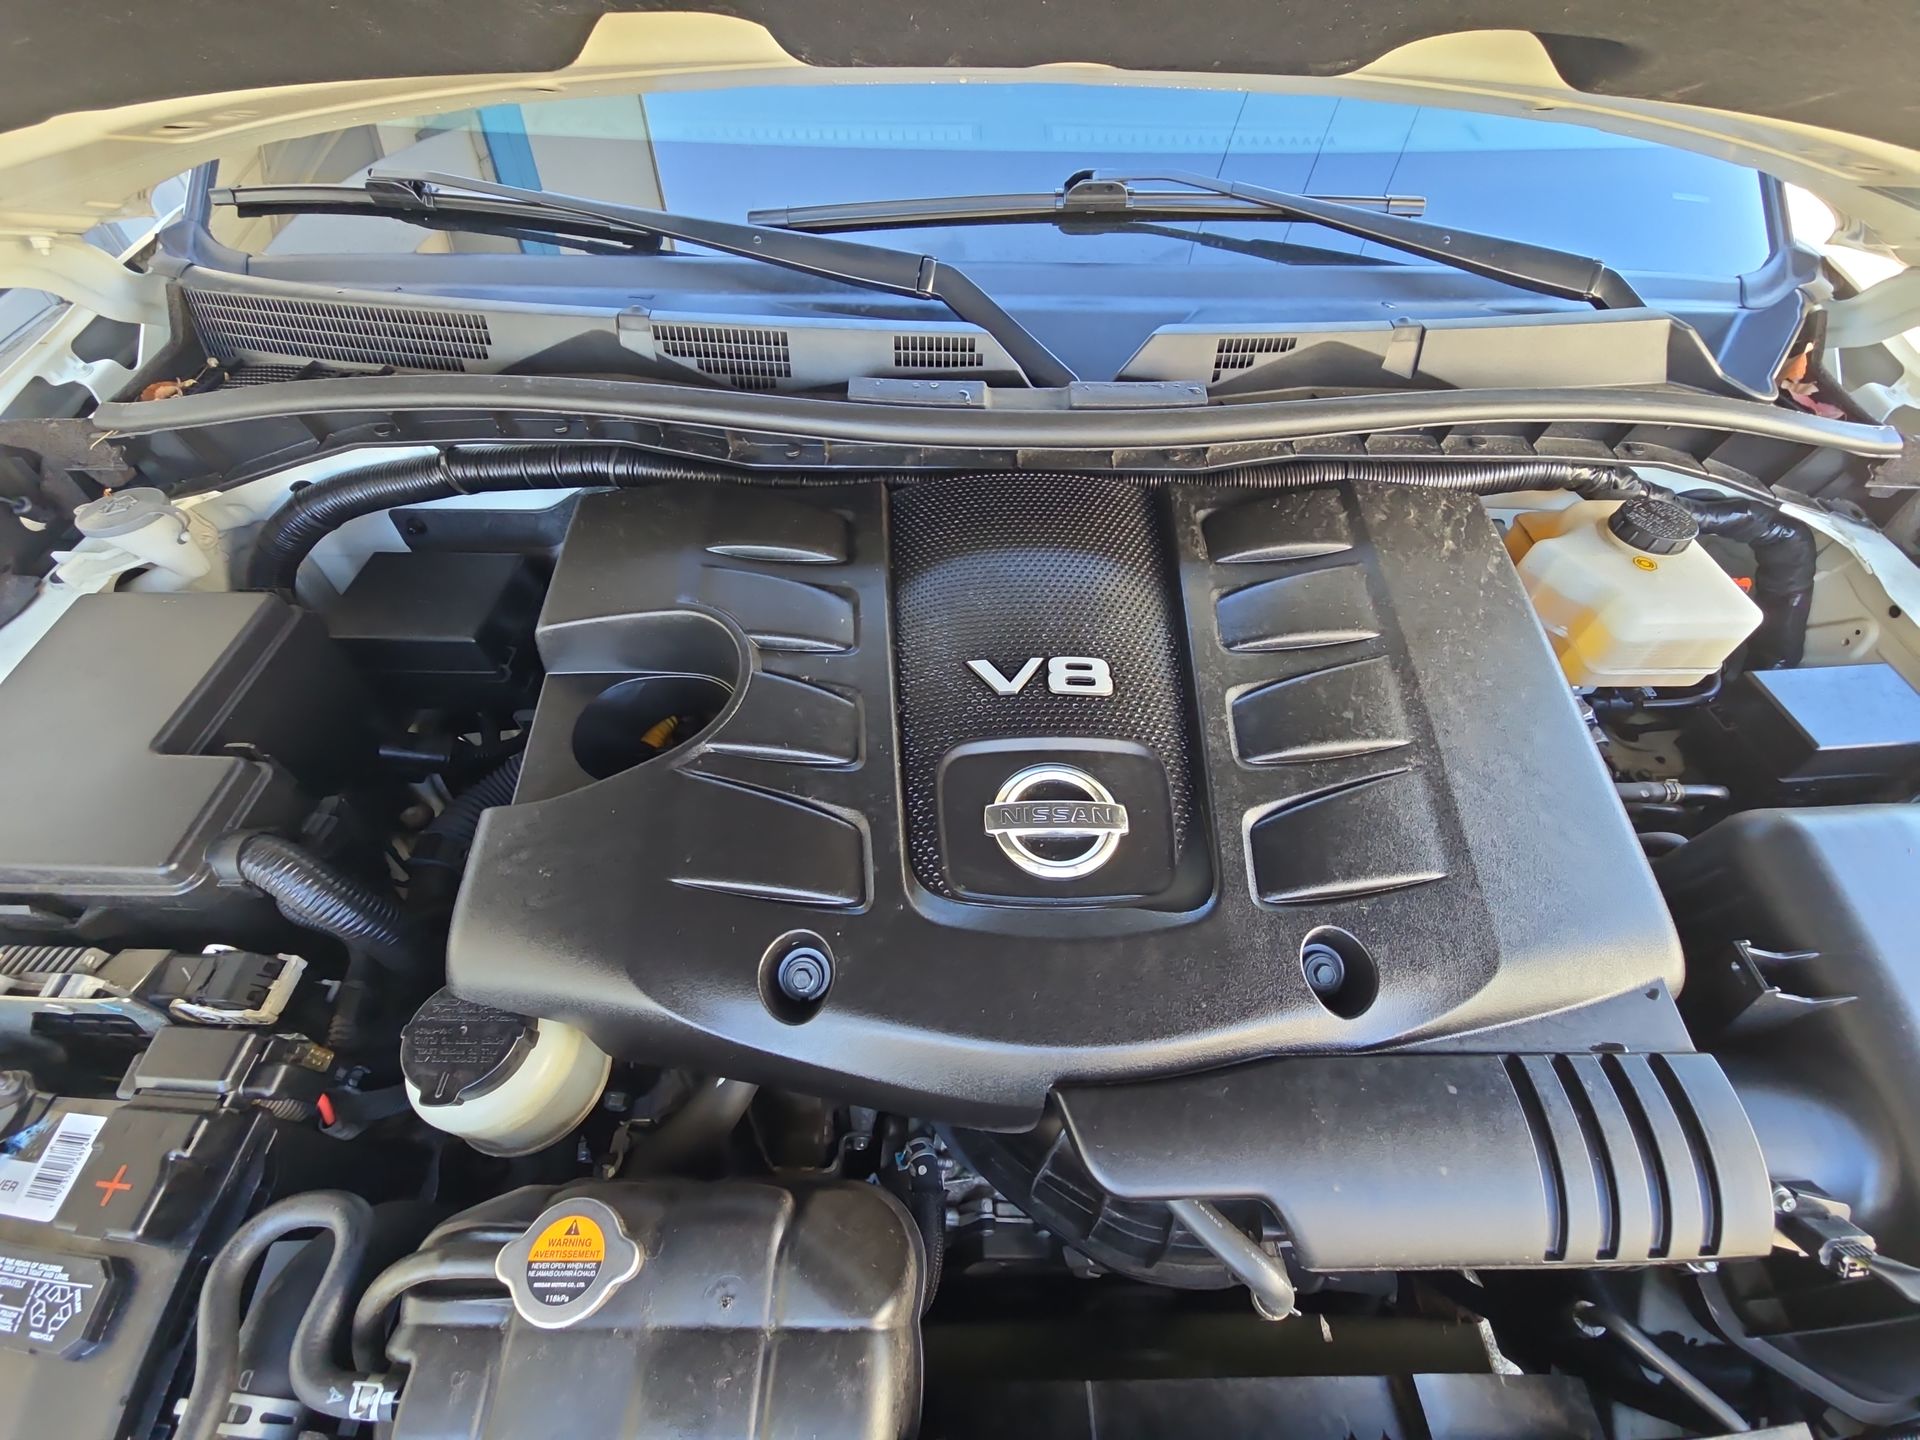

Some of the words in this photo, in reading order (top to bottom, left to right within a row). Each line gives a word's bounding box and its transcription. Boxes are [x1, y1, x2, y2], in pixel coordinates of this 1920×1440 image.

[966, 656, 1114, 696] V8
[1000, 806, 1114, 825] NISSAN
[548, 1238, 592, 1247] WARNING
[533, 1250, 601, 1259] AVERTISSEMENT
[531, 1262, 550, 1270] NEVER
[550, 1262, 566, 1270] OPEN
[566, 1262, 584, 1270] WHEN
